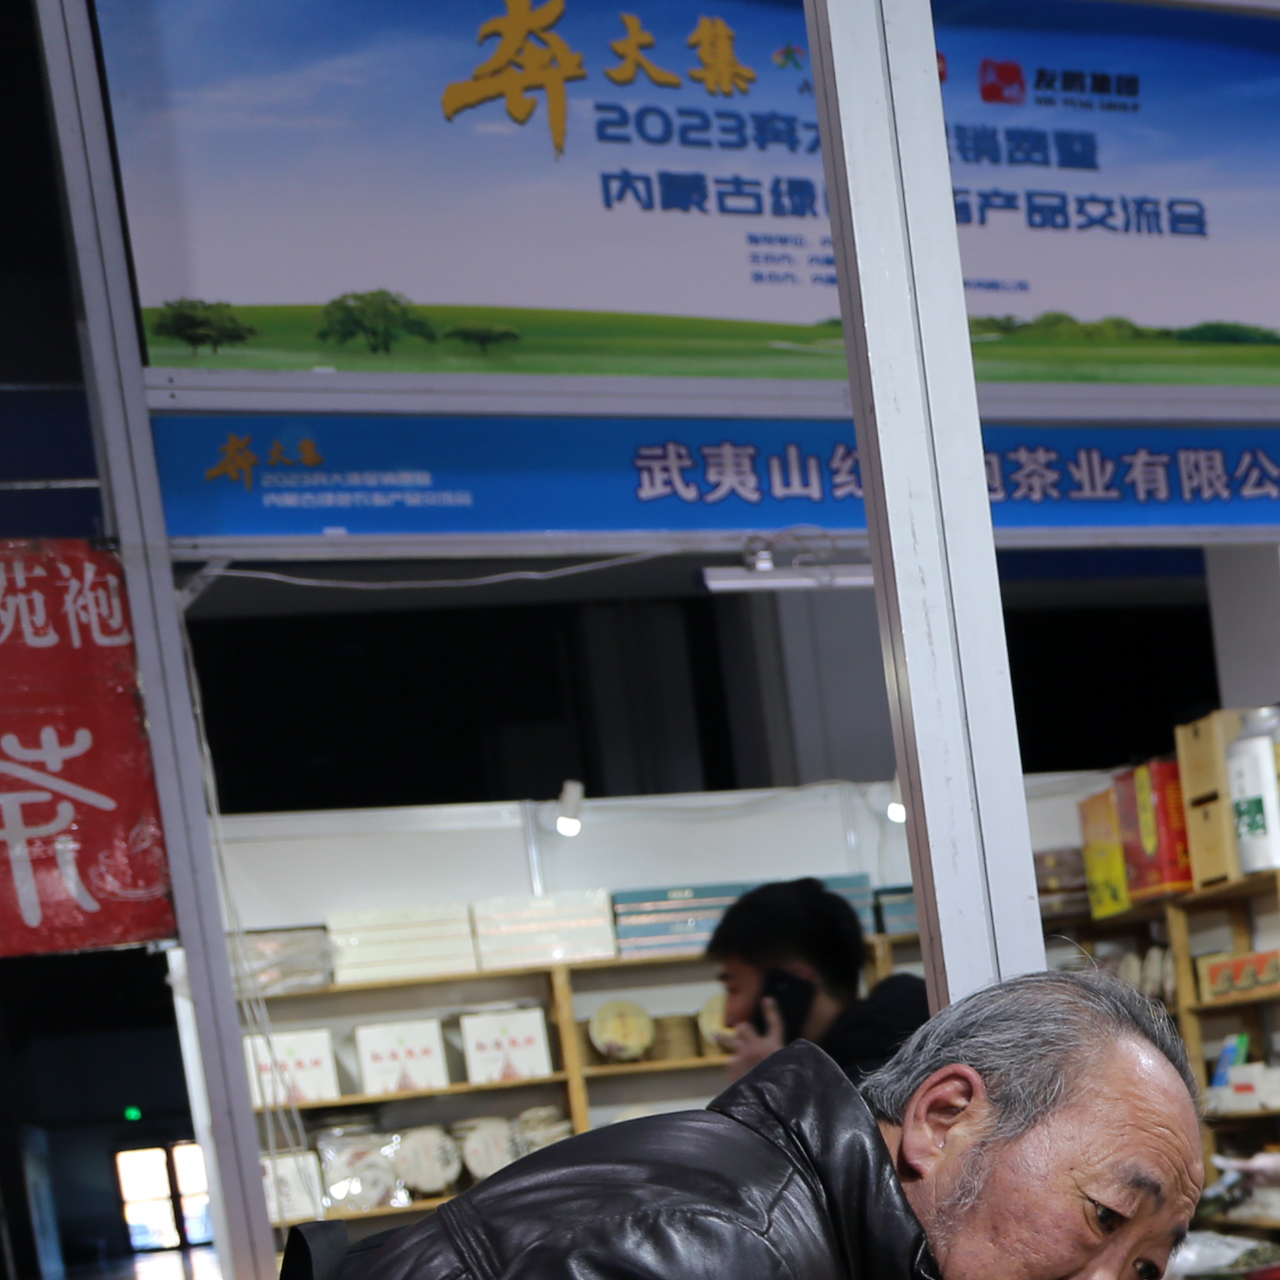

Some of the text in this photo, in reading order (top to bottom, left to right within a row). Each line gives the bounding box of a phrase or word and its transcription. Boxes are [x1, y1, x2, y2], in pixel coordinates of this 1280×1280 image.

[601, 170, 1208, 238] 内蒙古绿产品交流会
